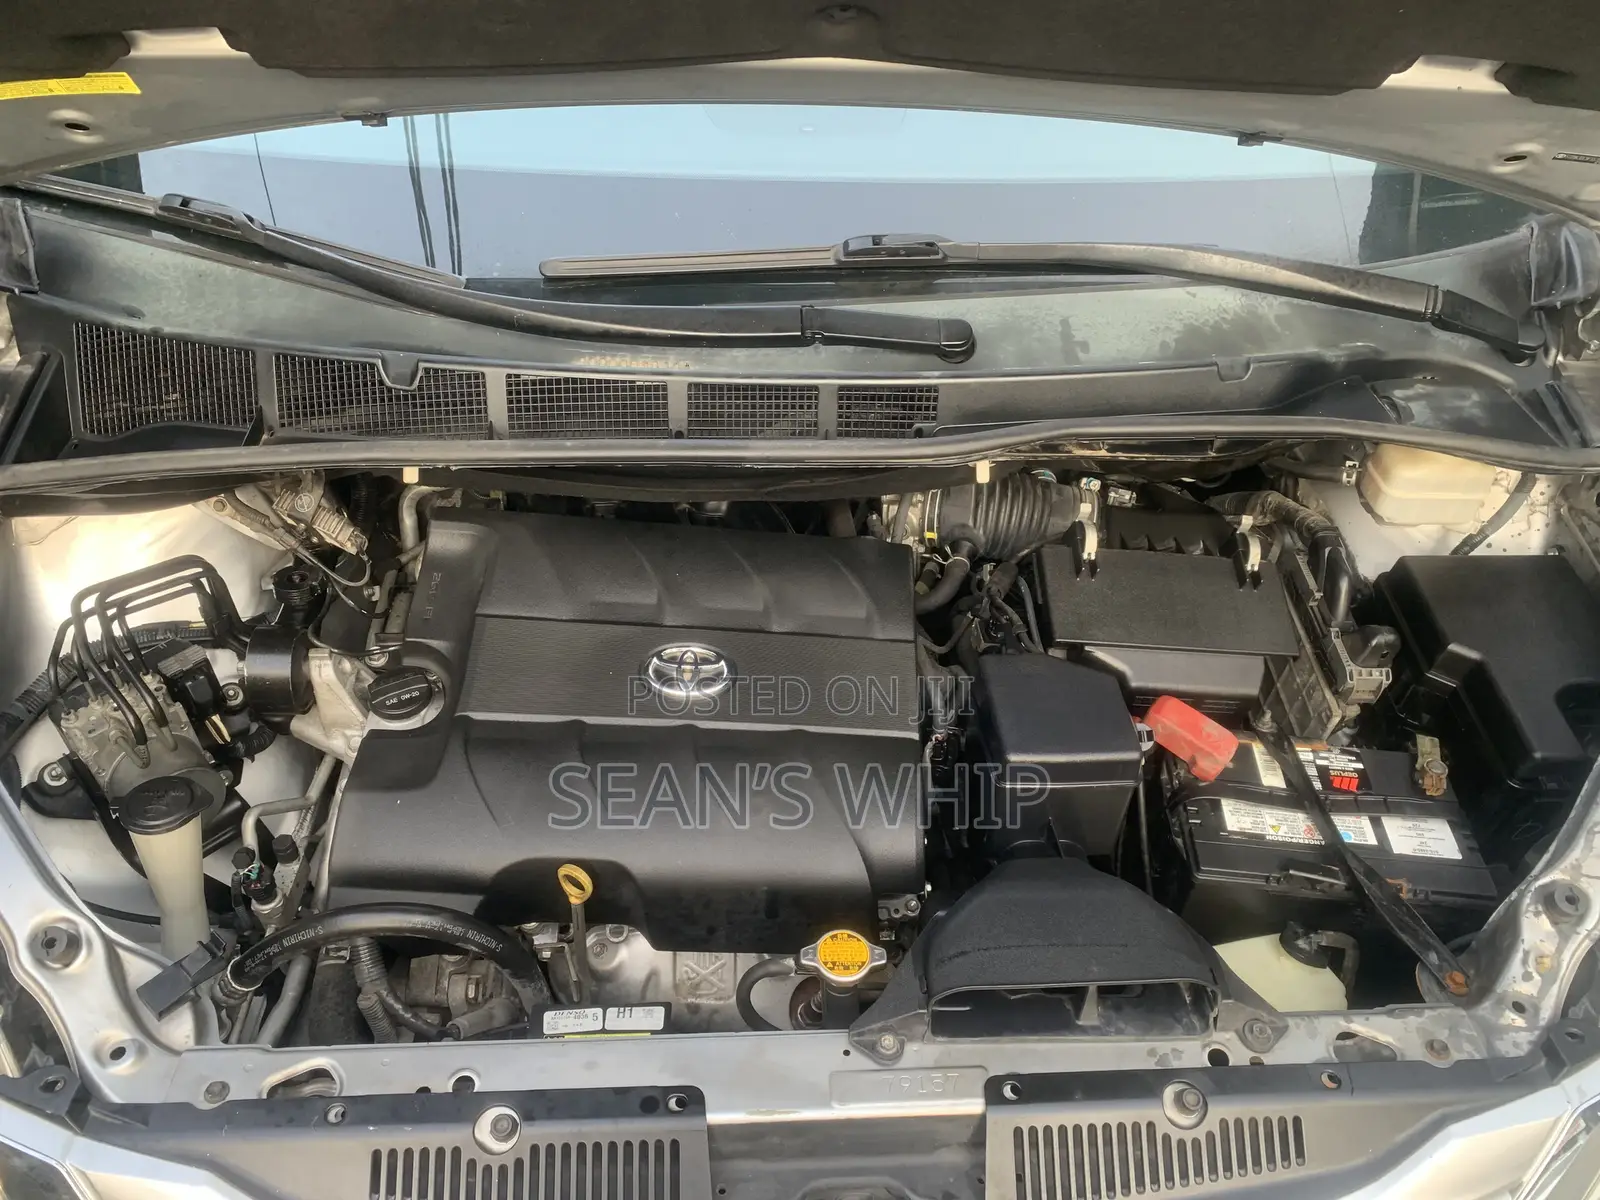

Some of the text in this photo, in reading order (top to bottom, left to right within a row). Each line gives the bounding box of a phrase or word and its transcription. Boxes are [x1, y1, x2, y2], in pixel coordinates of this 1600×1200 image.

[385, 690, 420, 706] SAE 0W-20
[592, 1012, 599, 1021] 5
[616, 1007, 633, 1018] H1
